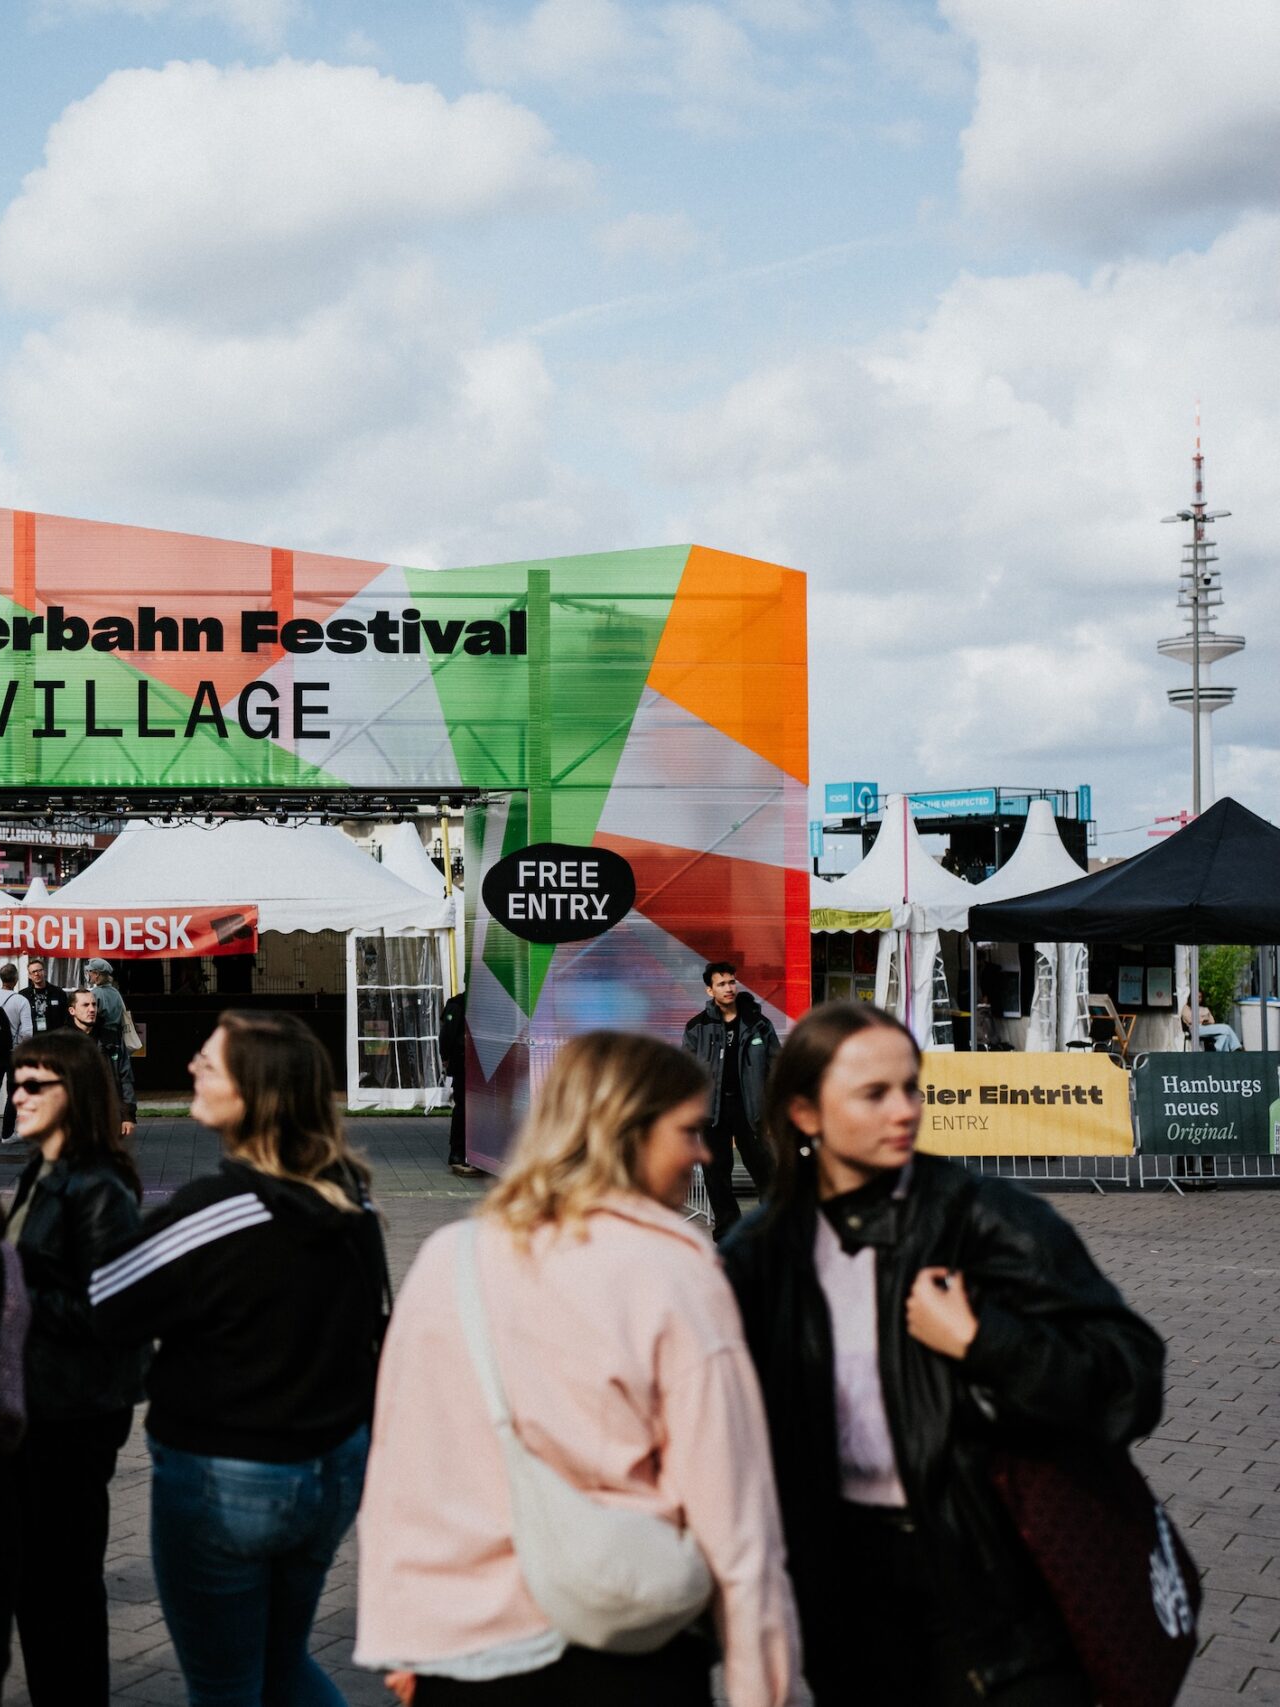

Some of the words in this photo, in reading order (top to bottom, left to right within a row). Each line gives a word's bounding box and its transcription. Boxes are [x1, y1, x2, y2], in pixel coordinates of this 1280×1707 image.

[241, 608, 527, 655] Festival
[518, 861, 599, 888] FREE
[508, 893, 610, 921] ENTRY
[97, 914, 194, 951] DESK
[979, 1084, 1104, 1105] Eintritt
[1161, 1075, 1262, 1097] Hamburgs
[1164, 1101, 1219, 1116] neues
[932, 1115, 989, 1131] ENTRY
[1166, 1121, 1238, 1144] Original.
